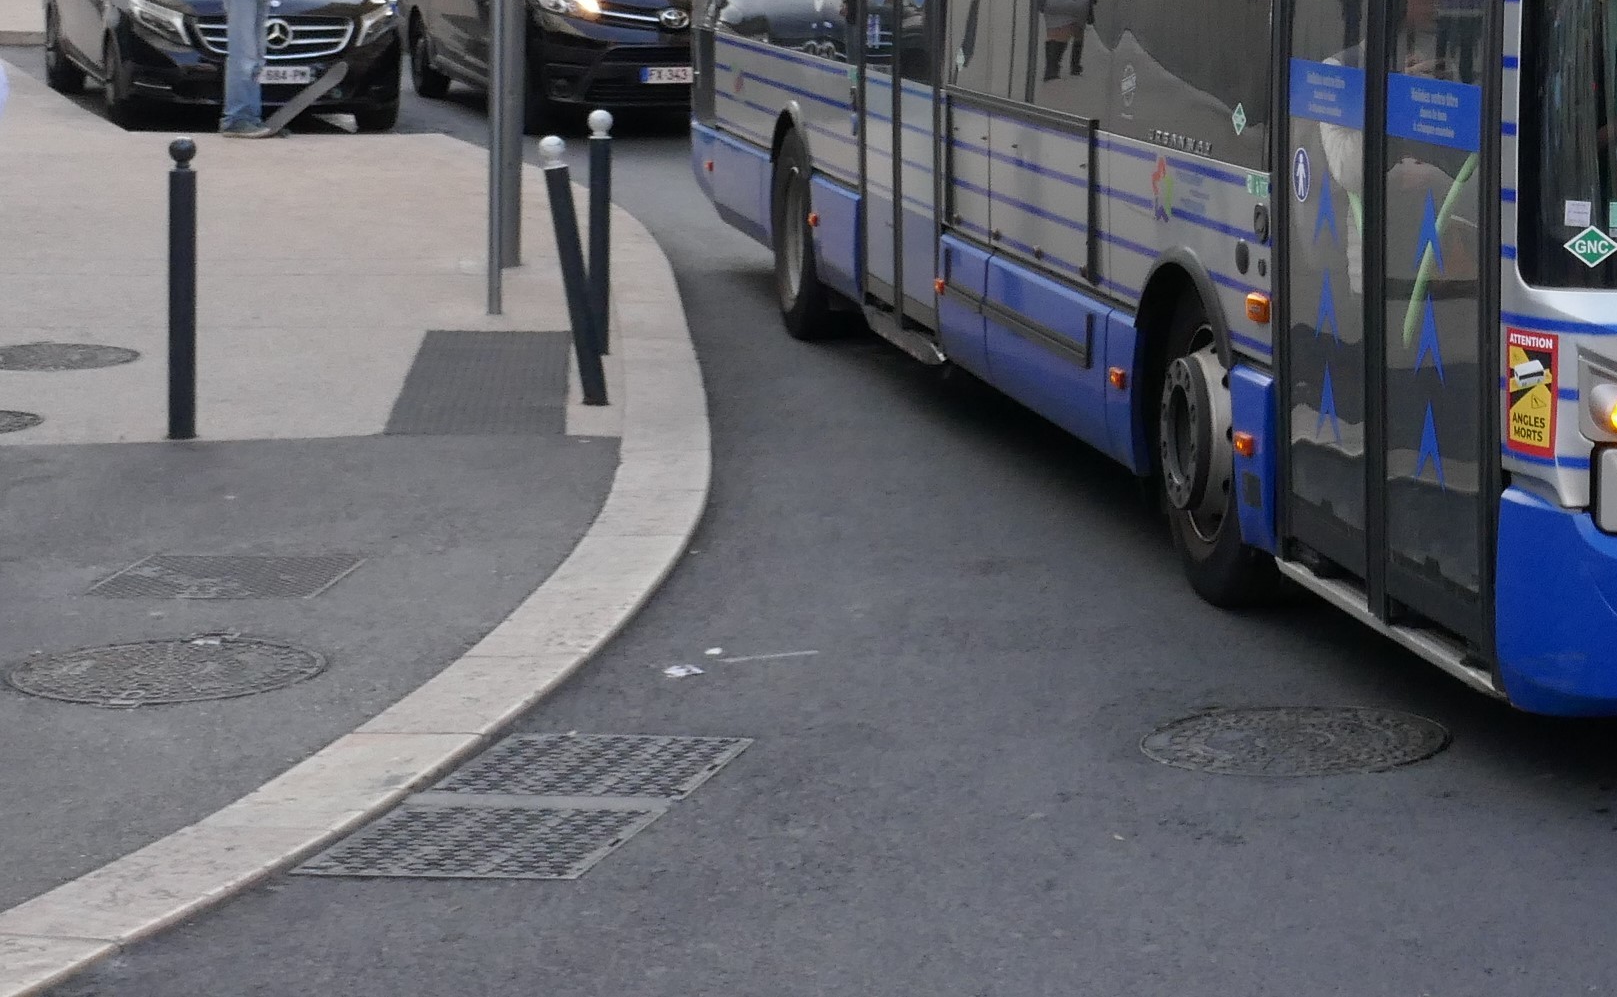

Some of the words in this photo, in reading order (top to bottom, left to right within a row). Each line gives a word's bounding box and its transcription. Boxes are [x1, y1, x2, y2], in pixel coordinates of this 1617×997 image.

[1574, 238, 1610, 255] GNC
[1509, 332, 1553, 350] ATTENTION
[1512, 411, 1546, 429] ANGLES
[1514, 426, 1543, 443] MORTS
